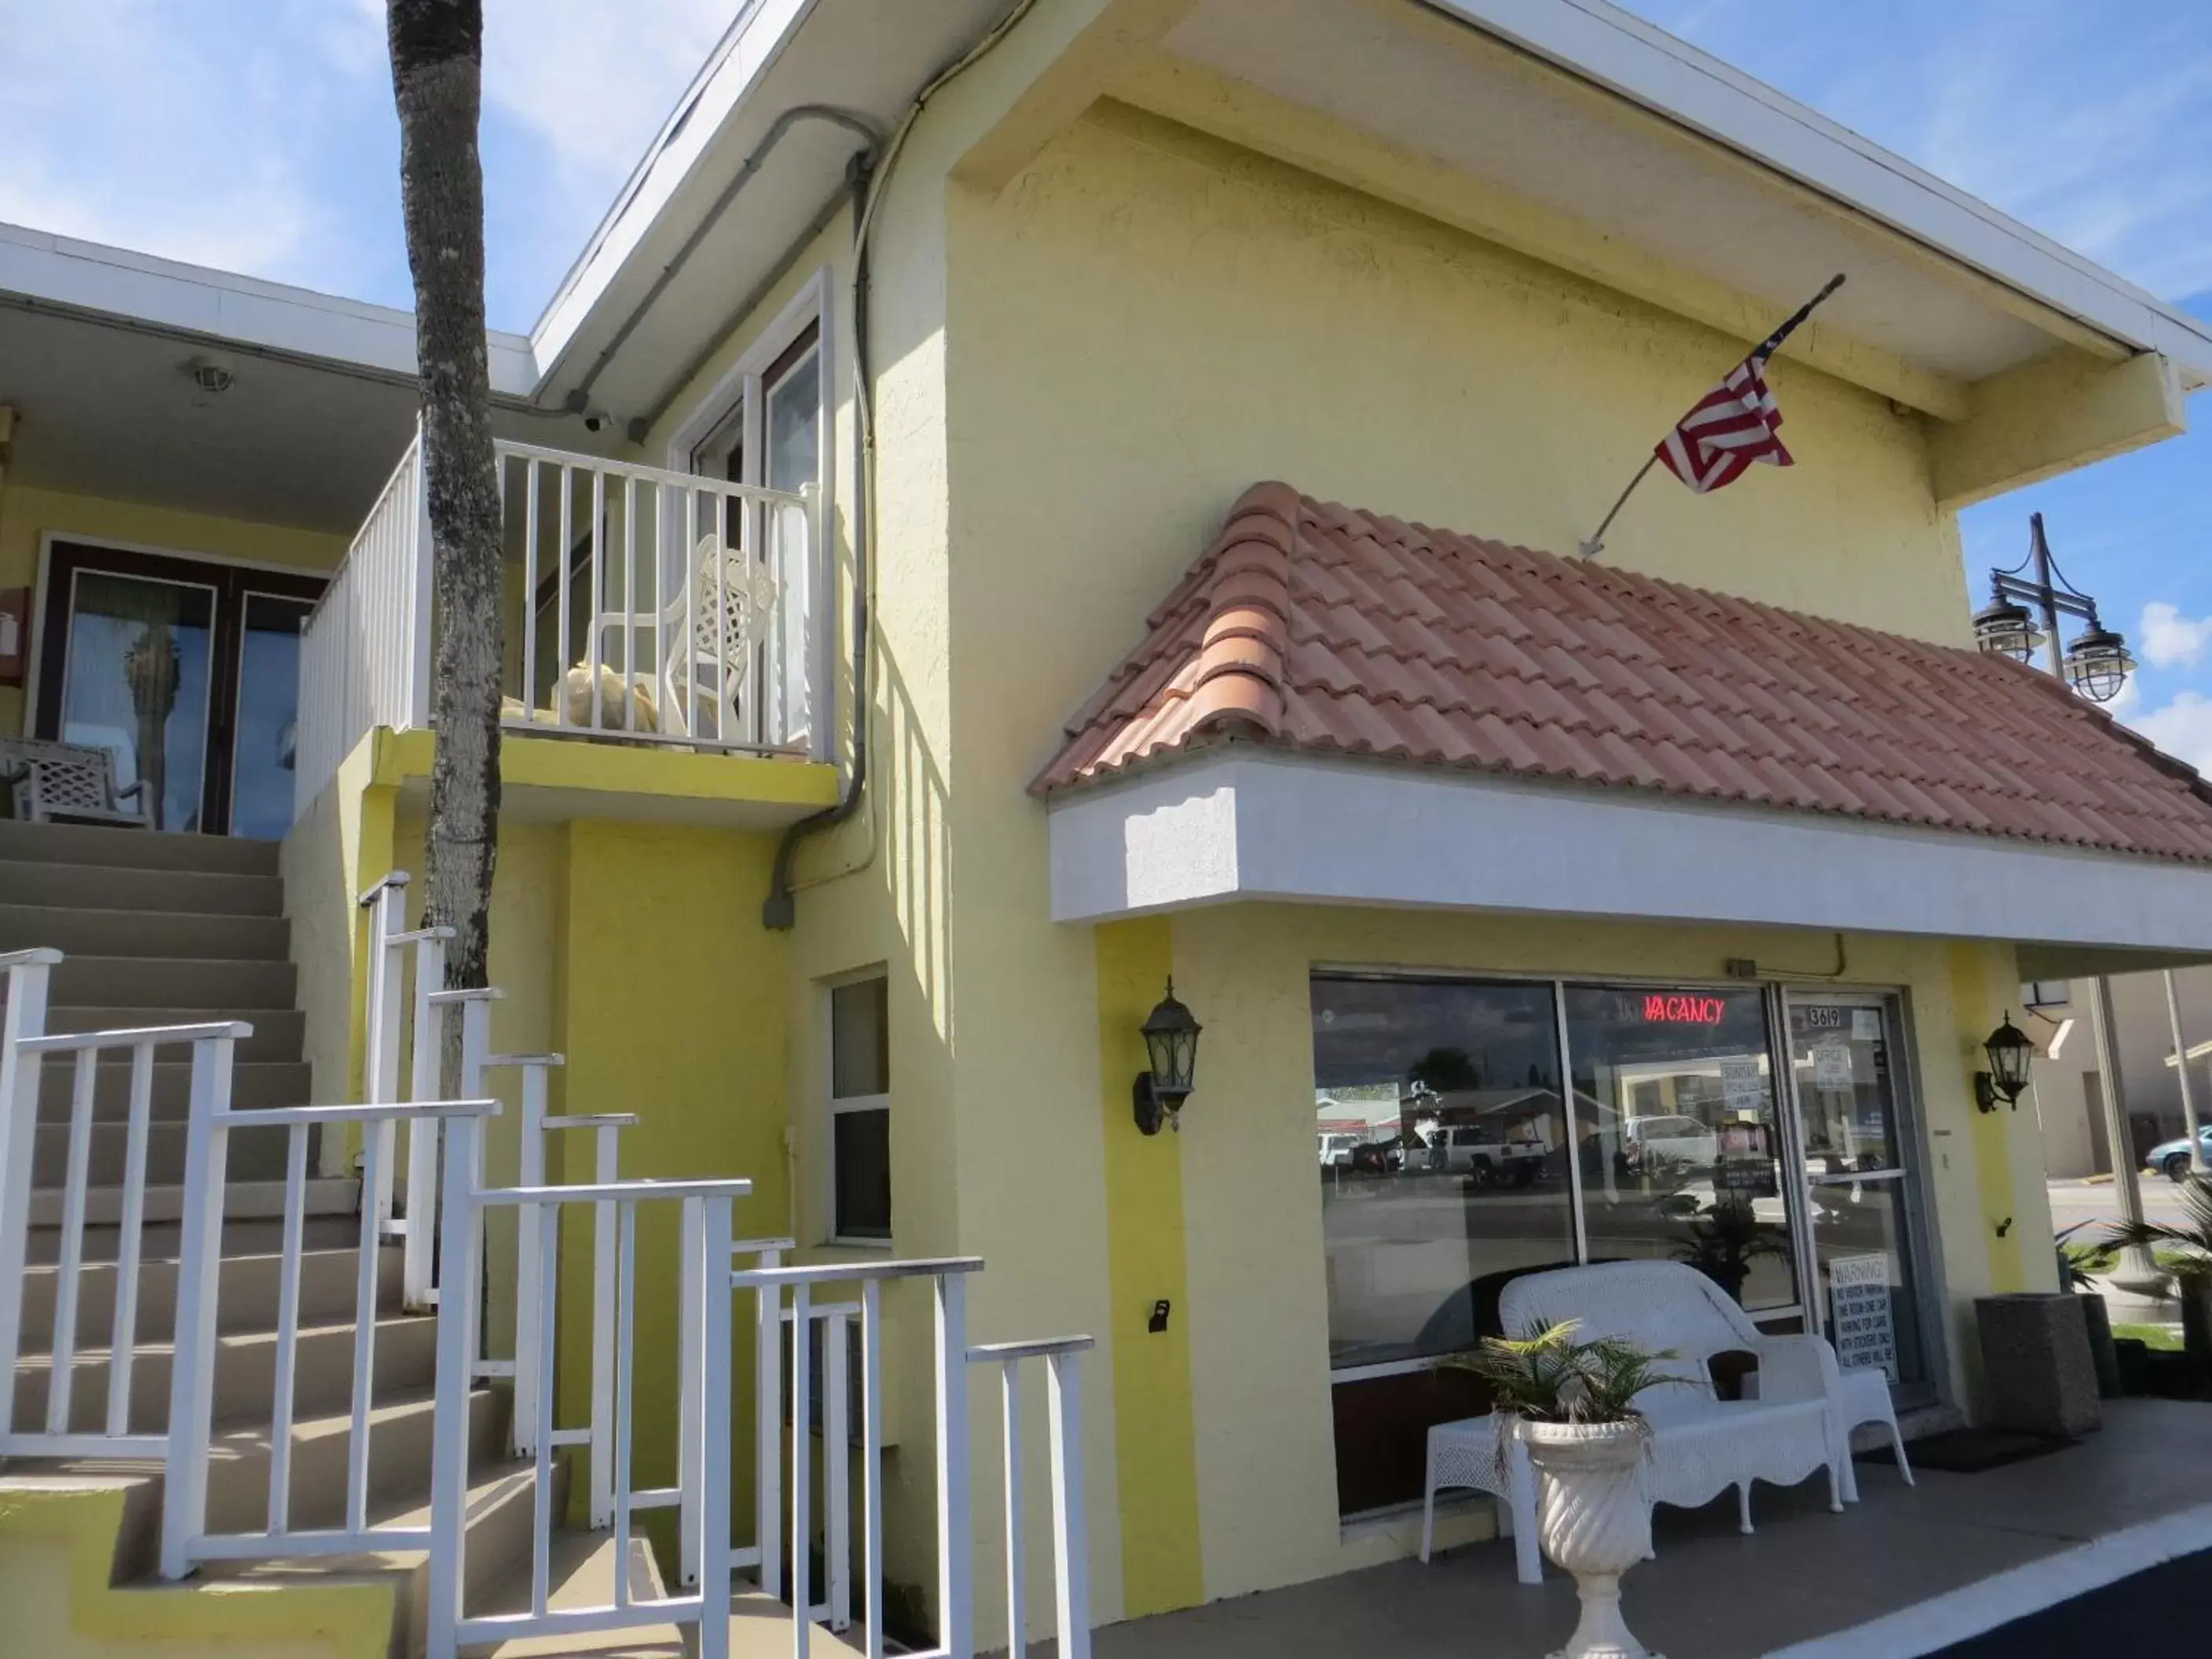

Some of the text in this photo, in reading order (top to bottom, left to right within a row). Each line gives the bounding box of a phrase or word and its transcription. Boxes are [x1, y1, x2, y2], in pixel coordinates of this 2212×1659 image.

[1645, 994, 1725, 1024] VACANCY
[1811, 1009, 1838, 1026] 3619
[1724, 1065, 1756, 1079] SUNDAY
[1835, 1259, 1885, 1284] WARNING!
